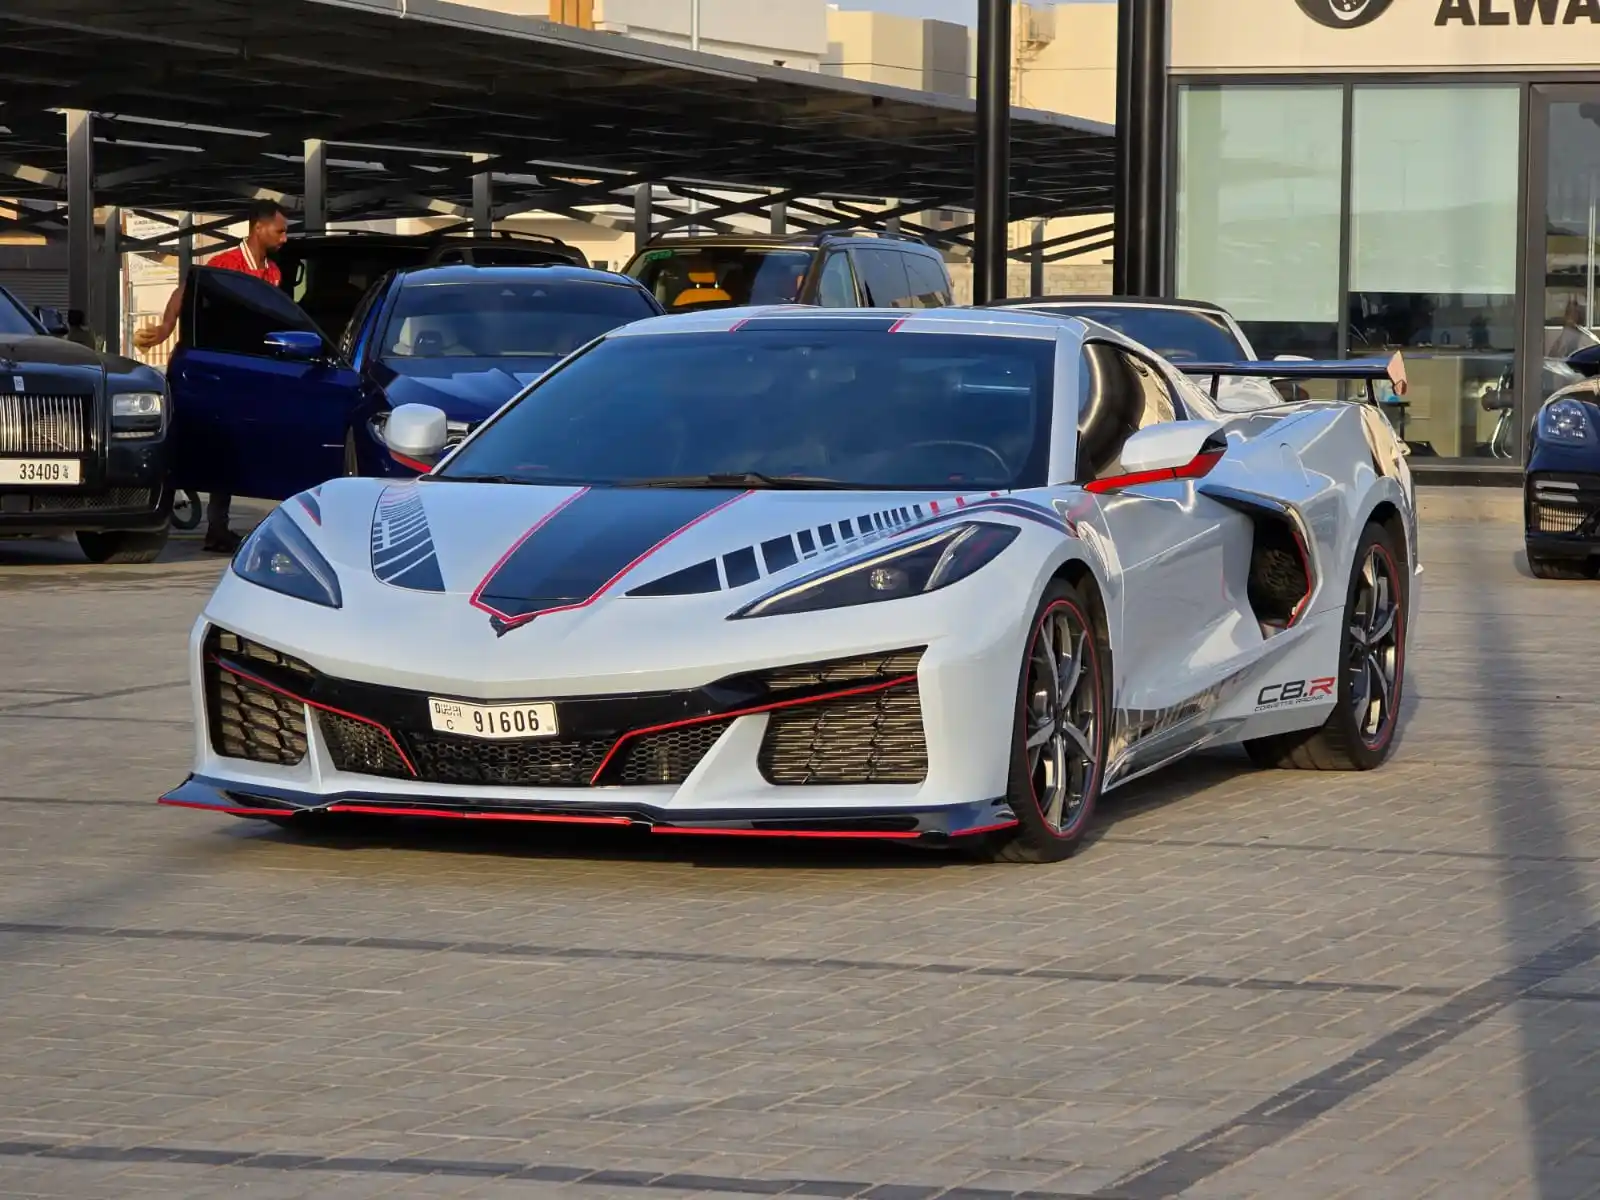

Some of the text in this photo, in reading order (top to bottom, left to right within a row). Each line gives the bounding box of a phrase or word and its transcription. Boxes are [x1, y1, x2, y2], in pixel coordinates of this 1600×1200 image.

[20, 463, 60, 480] 33409
[1257, 677, 1336, 705] C8.R
[446, 719, 454, 730] C
[473, 709, 540, 733] 91606
